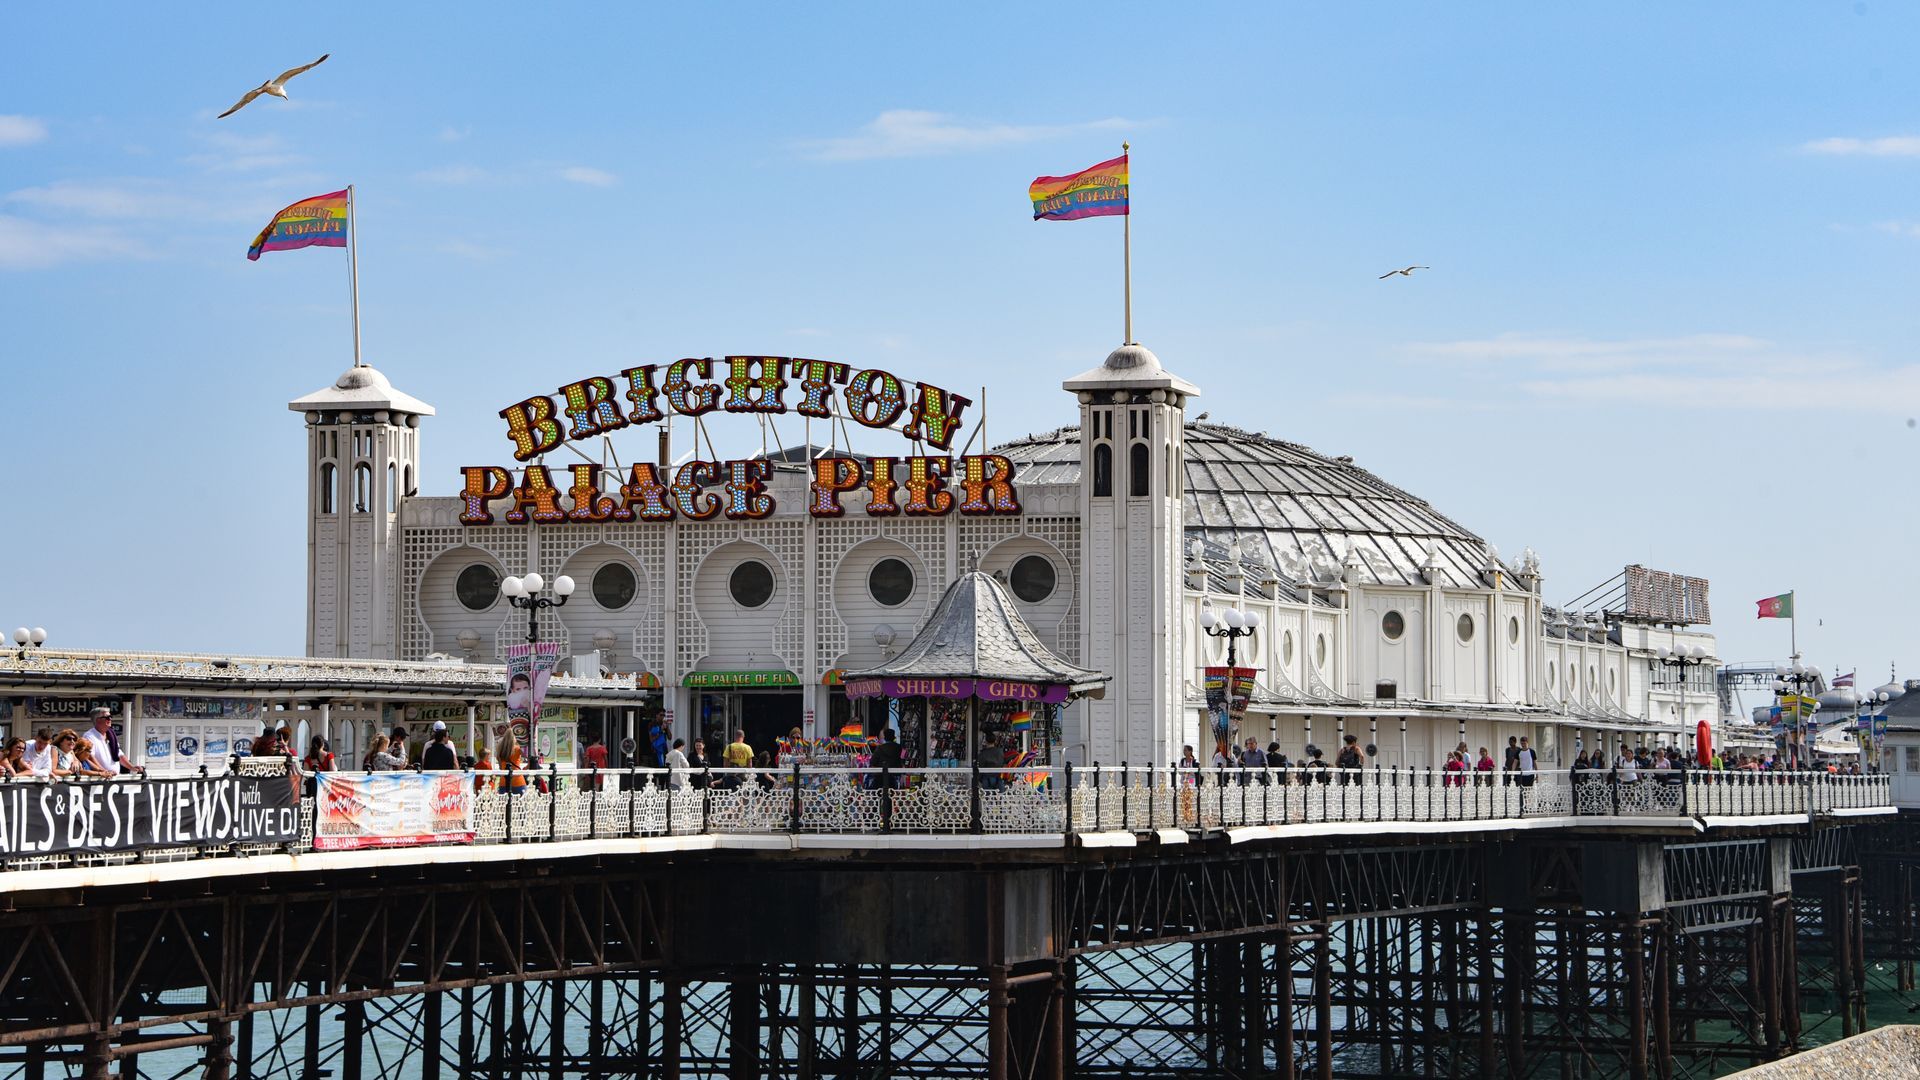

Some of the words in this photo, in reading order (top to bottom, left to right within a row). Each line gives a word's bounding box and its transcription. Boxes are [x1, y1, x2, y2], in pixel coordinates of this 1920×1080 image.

[499, 355, 972, 462] BRIGHTON
[459, 459, 776, 526] PALACE
[809, 453, 1023, 518] PIER
[508, 655, 529, 664] CANDY
[512, 665, 532, 673] FLOSS
[689, 674, 708, 684] THE
[712, 674, 751, 684] PALACE
[755, 674, 768, 684] OF
[773, 673, 793, 683] FUN
[846, 680, 881, 696] SOUVENIRS
[896, 679, 959, 695] SHELLS
[989, 681, 1038, 698] GIFTS
[42, 701, 87, 713] SLUSH
[185, 702, 207, 713] SLUSH
[208, 703, 222, 713] BAR
[421, 709, 440, 719] ICE
[442, 705, 468, 718] CREA
[241, 781, 262, 805] with
[55, 794, 66, 815] &
[67, 783, 142, 848] BEST
[149, 779, 240, 843] VIEWS!
[241, 808, 275, 836] LIVE
[280, 807, 298, 836] DJ
